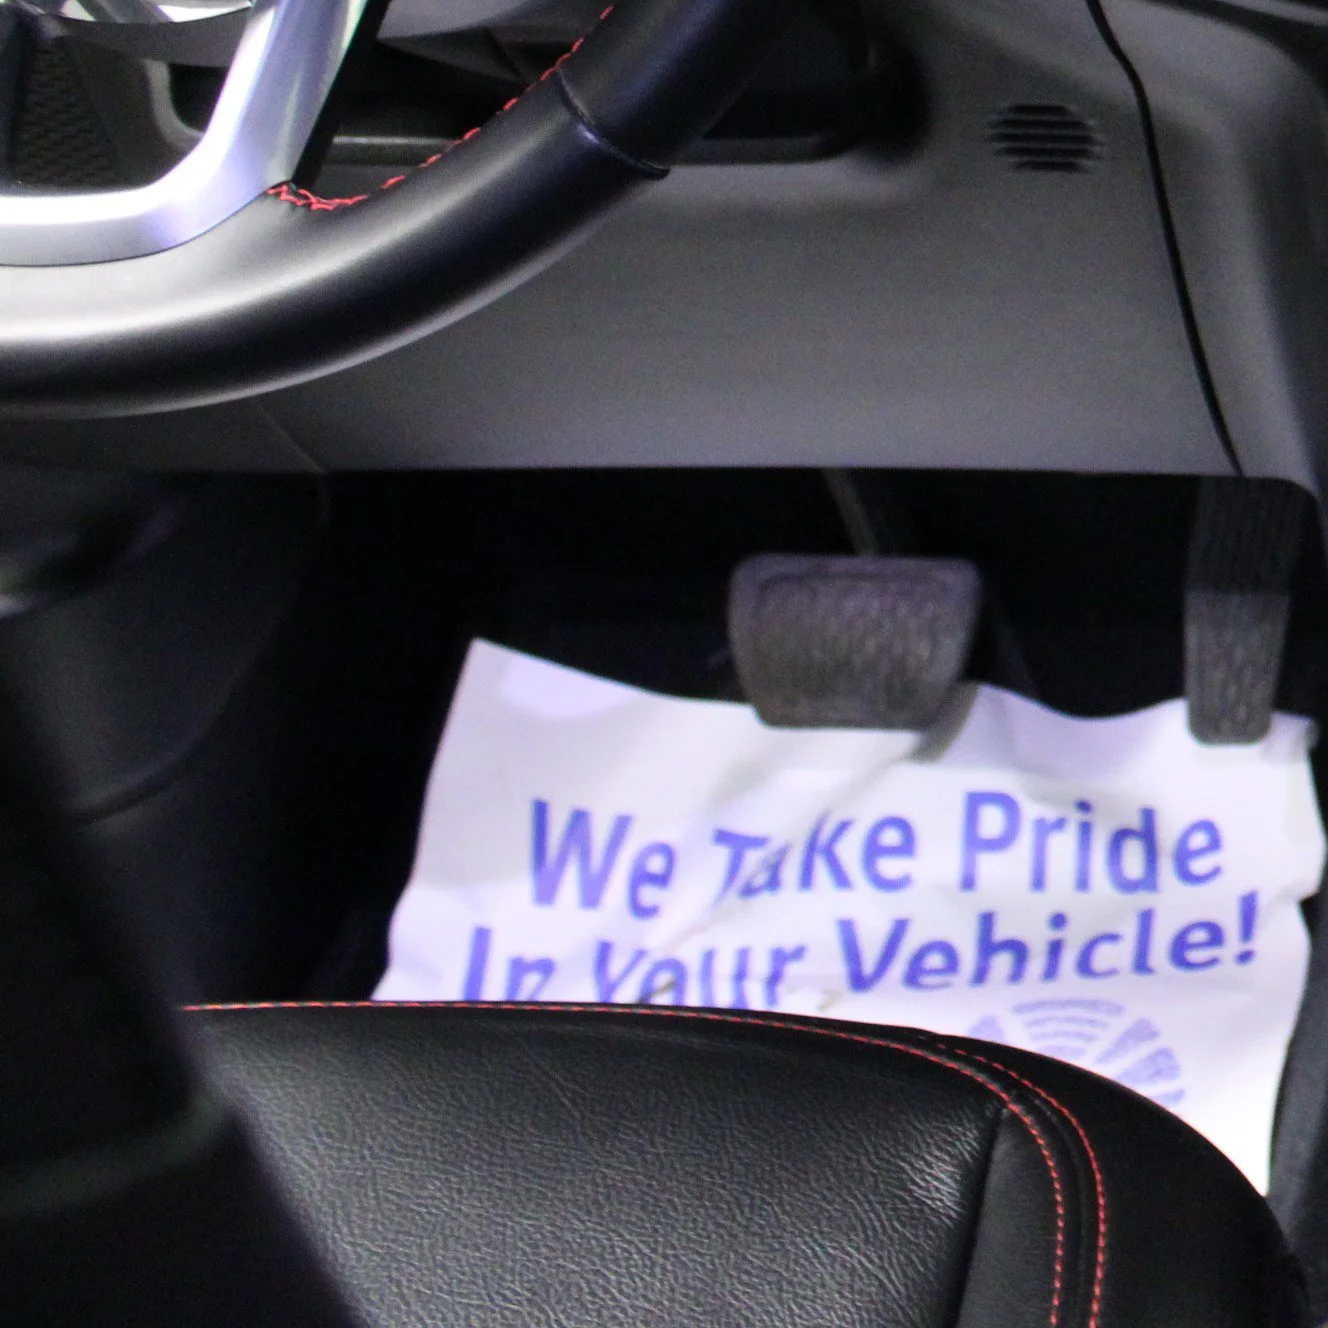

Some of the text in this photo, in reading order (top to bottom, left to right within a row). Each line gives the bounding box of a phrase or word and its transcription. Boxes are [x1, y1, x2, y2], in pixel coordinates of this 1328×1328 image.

[530, 790, 1224, 919] We Take Pride
[595, 940, 806, 1008] Your
[837, 890, 1259, 992] Vehicle!
